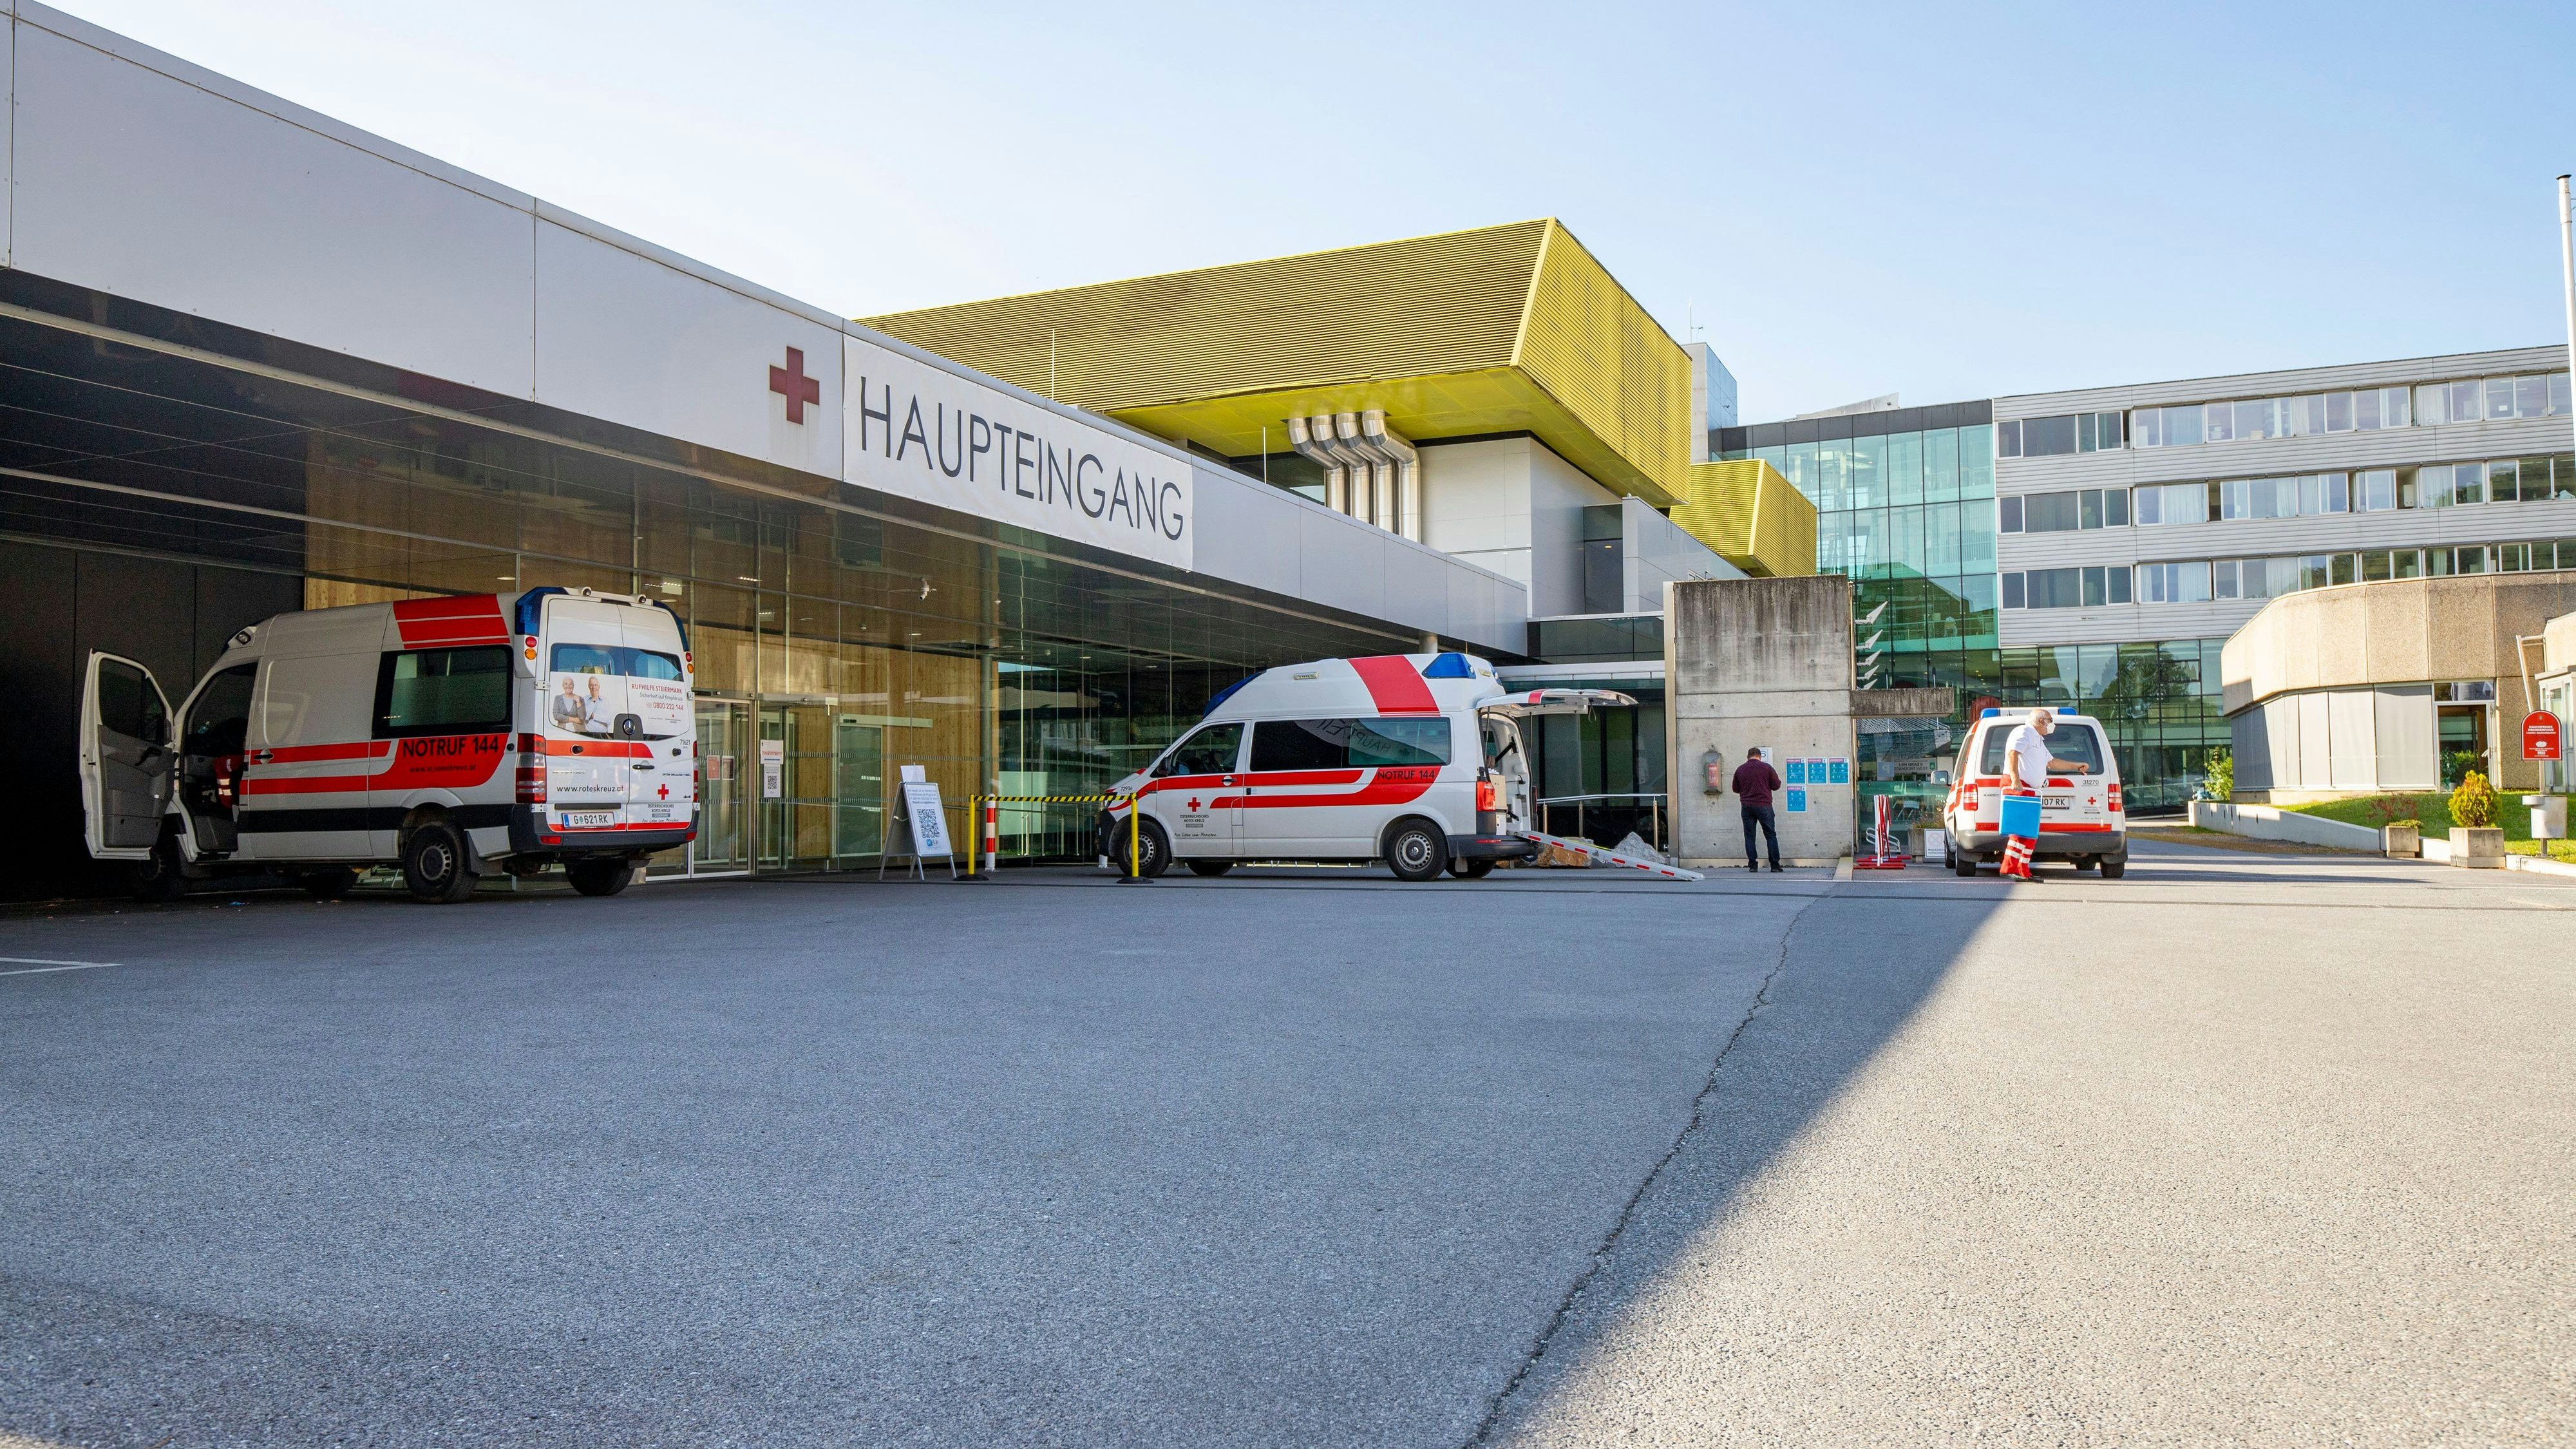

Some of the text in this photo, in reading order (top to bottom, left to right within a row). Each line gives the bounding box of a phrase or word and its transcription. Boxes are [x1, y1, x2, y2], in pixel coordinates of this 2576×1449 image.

[860, 376, 1184, 541] HAUPTEINGANG
[656, 685, 682, 694] STEIERMARK
[403, 736, 498, 758] NOTRUF 144
[1378, 770, 1435, 780] NOTRUF 144
[574, 815, 579, 824] G
